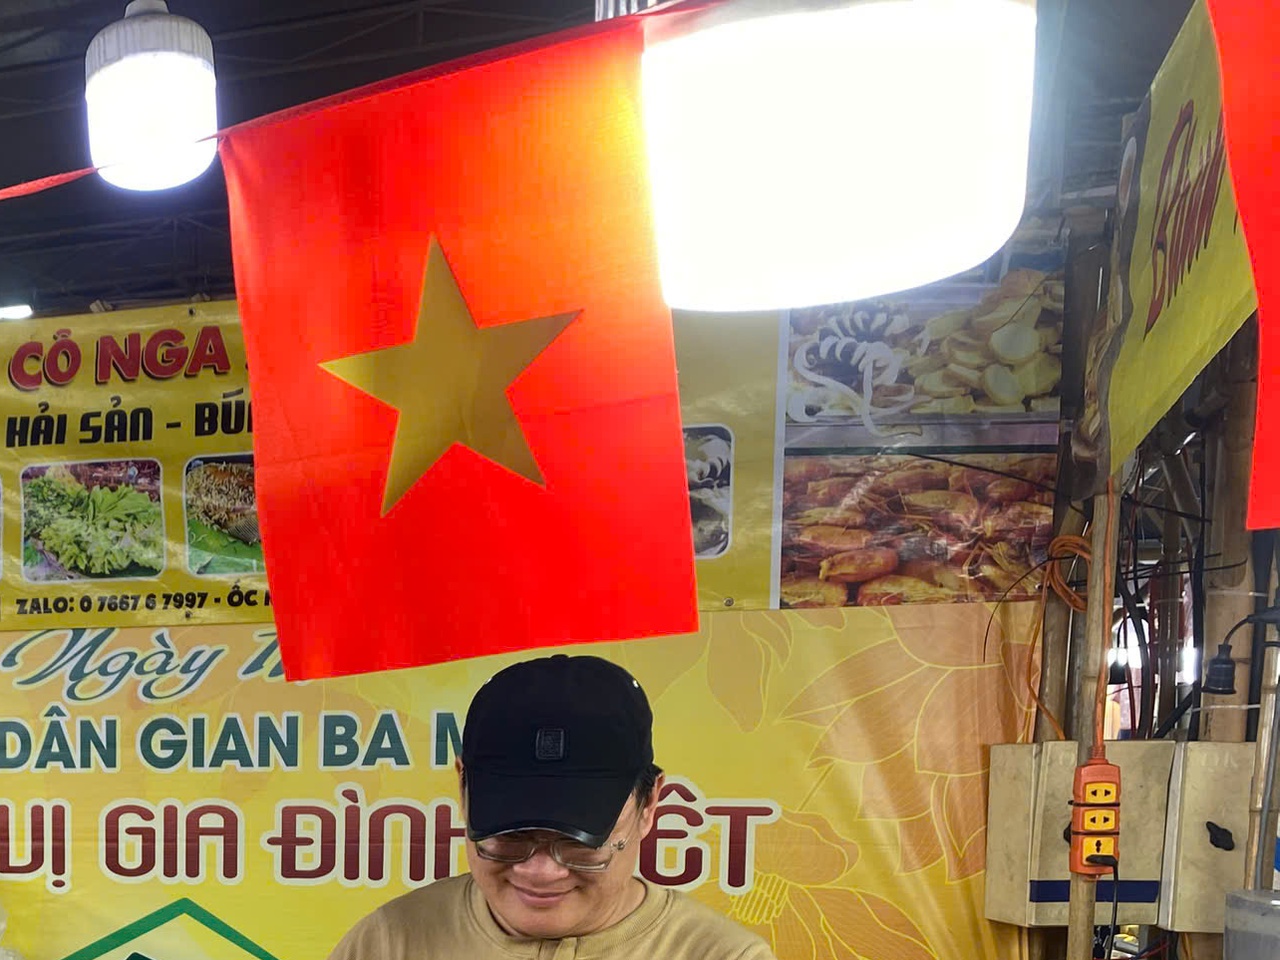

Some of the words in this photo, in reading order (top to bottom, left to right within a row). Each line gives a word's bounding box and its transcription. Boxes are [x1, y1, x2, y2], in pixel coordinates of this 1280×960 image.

[9, 329, 82, 391] CÔ
[95, 326, 231, 385] NGA
[5, 401, 68, 448] HẢI
[78, 395, 154, 443] SẢN
[15, 596, 75, 615] ZALO:
[162, 592, 209, 610] 7997
[1, 627, 225, 701] Ngày
[140, 715, 299, 769] GIAN
[323, 713, 410, 767] BA
[105, 804, 238, 881] GIA
